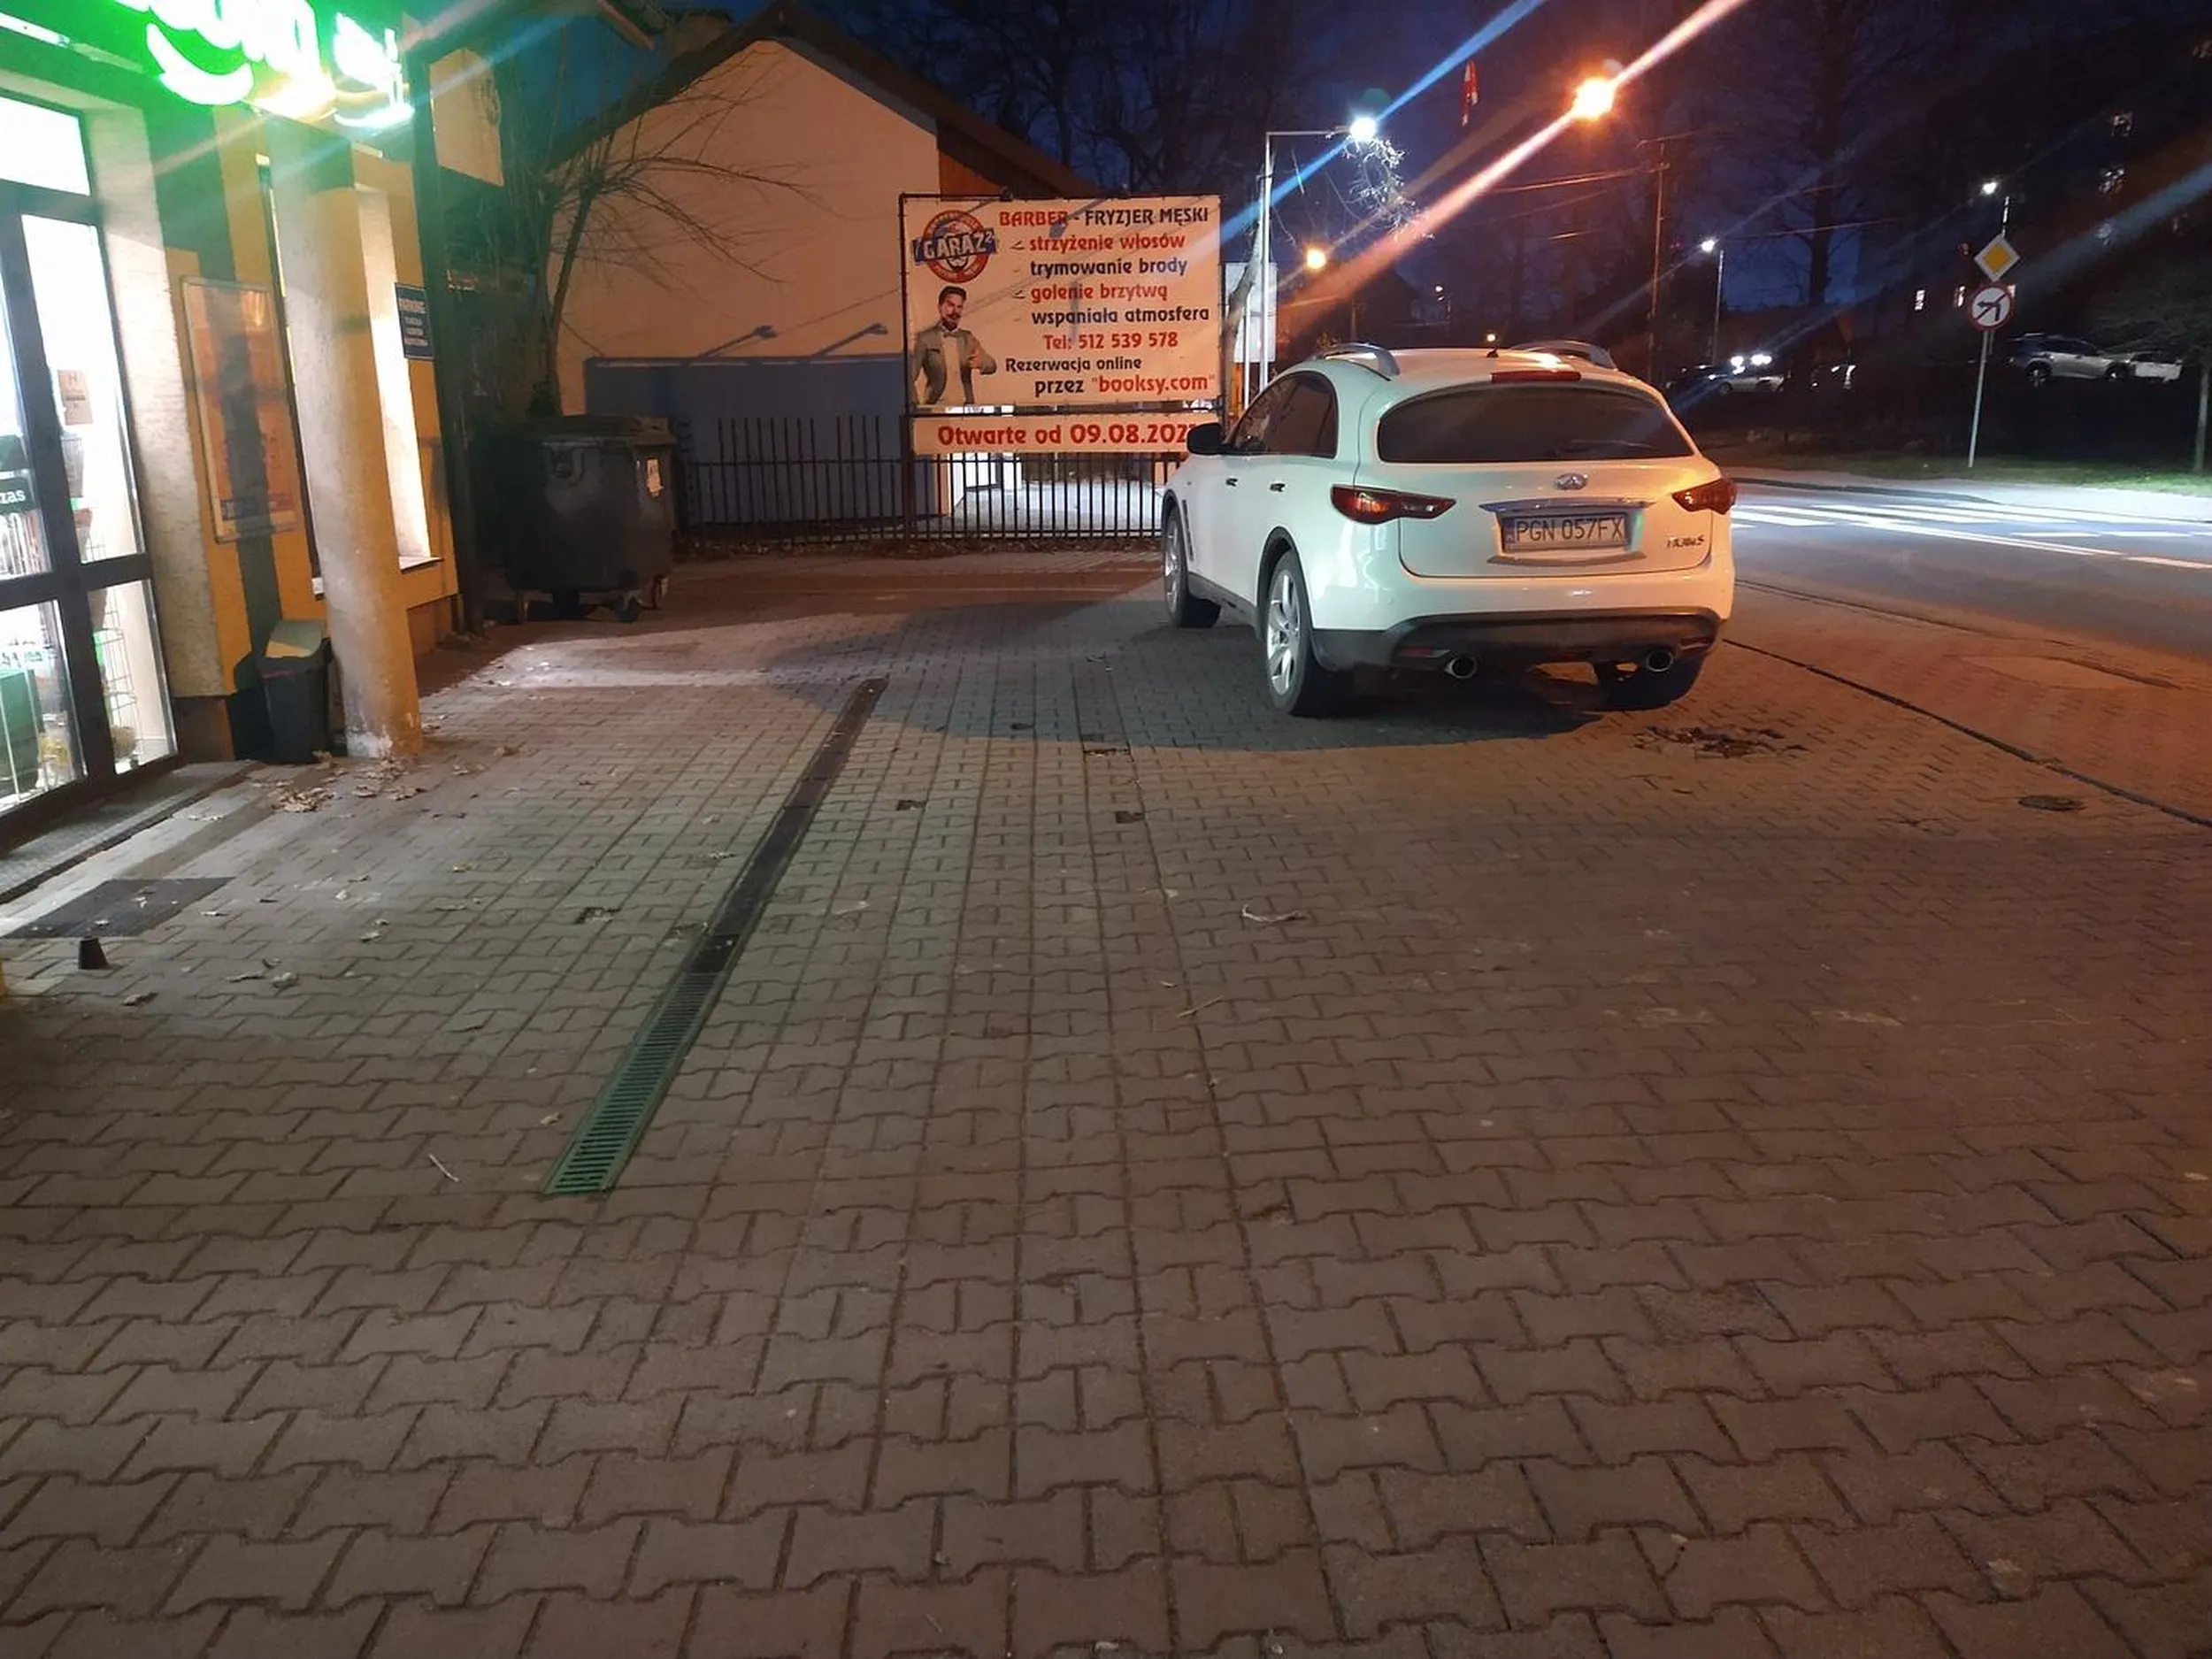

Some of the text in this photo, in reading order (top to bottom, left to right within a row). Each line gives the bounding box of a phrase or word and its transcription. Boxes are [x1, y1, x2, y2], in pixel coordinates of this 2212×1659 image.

[999, 211, 1068, 227] BARBER
[1085, 209, 1154, 227] FRYZJER
[1159, 207, 1209, 226] MĘSKI
[1030, 232, 1186, 253] strzyżenie włosów
[1031, 257, 1187, 280] trymowanie brody
[1031, 283, 1168, 303] golenie brzytwą
[1032, 305, 1210, 327] wspaniała atmosfera
[1079, 334, 1104, 349] 512
[1111, 334, 1142, 349] 539
[1148, 332, 1179, 348] 578
[1005, 357, 1142, 373] Rezerwacja online
[1035, 379, 1085, 397] przez
[938, 423, 1197, 446] Otwarte od 09.08.202
[1517, 517, 1624, 541] PGN 057FX
